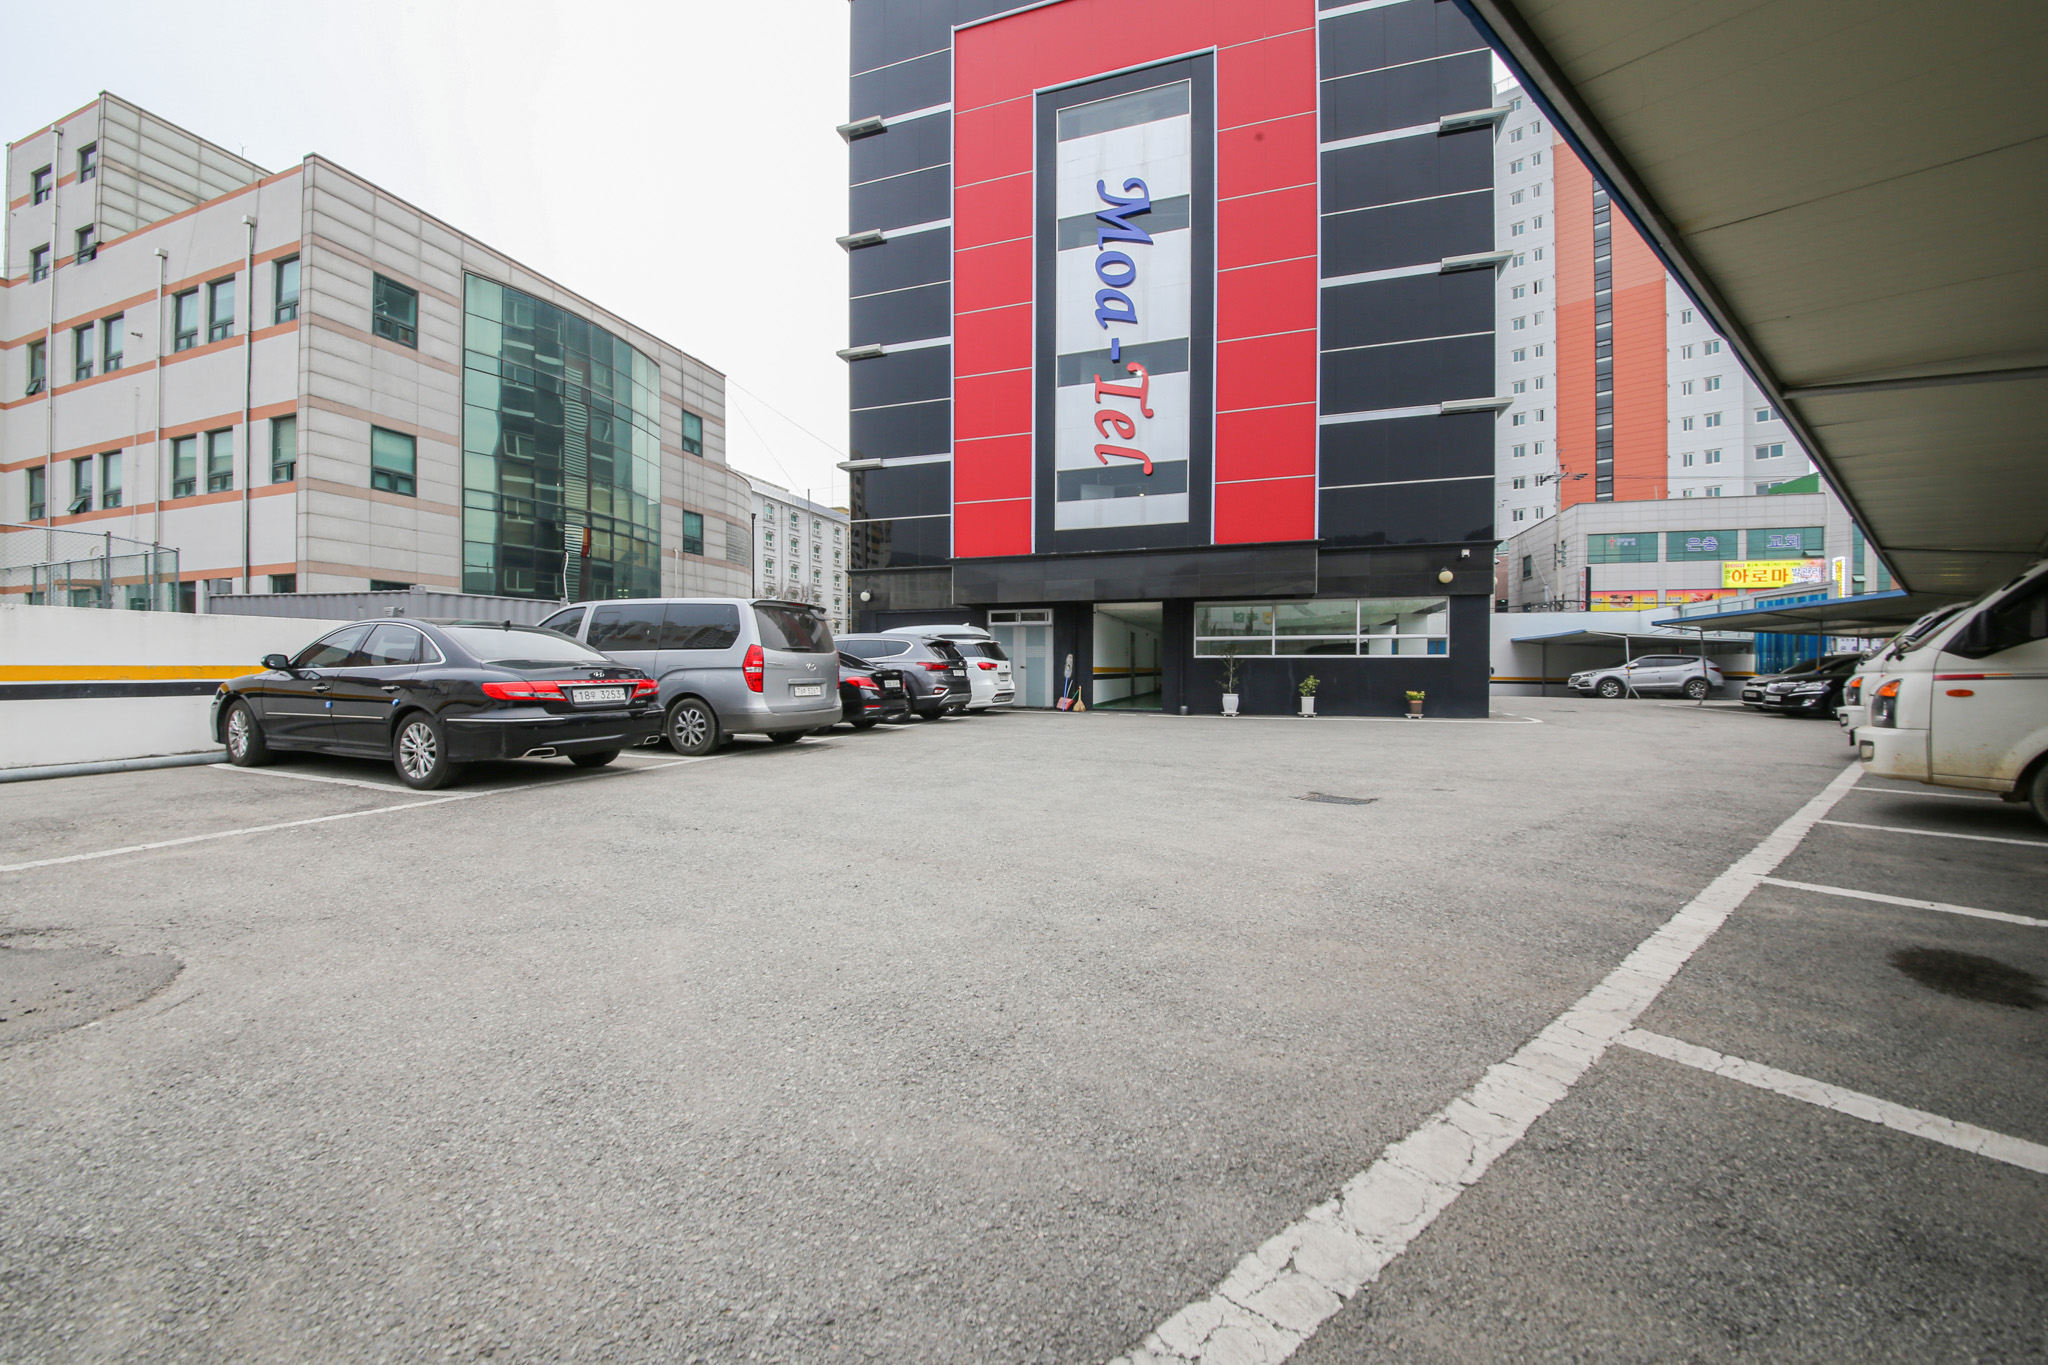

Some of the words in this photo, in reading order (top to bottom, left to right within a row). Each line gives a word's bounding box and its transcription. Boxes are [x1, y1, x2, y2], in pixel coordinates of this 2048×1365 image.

[1094, 177, 1154, 475] Moa-Tel
[1767, 533, 1801, 550] 교회
[1731, 567, 1789, 583] 아로마
[600, 689, 622, 700] 3253
